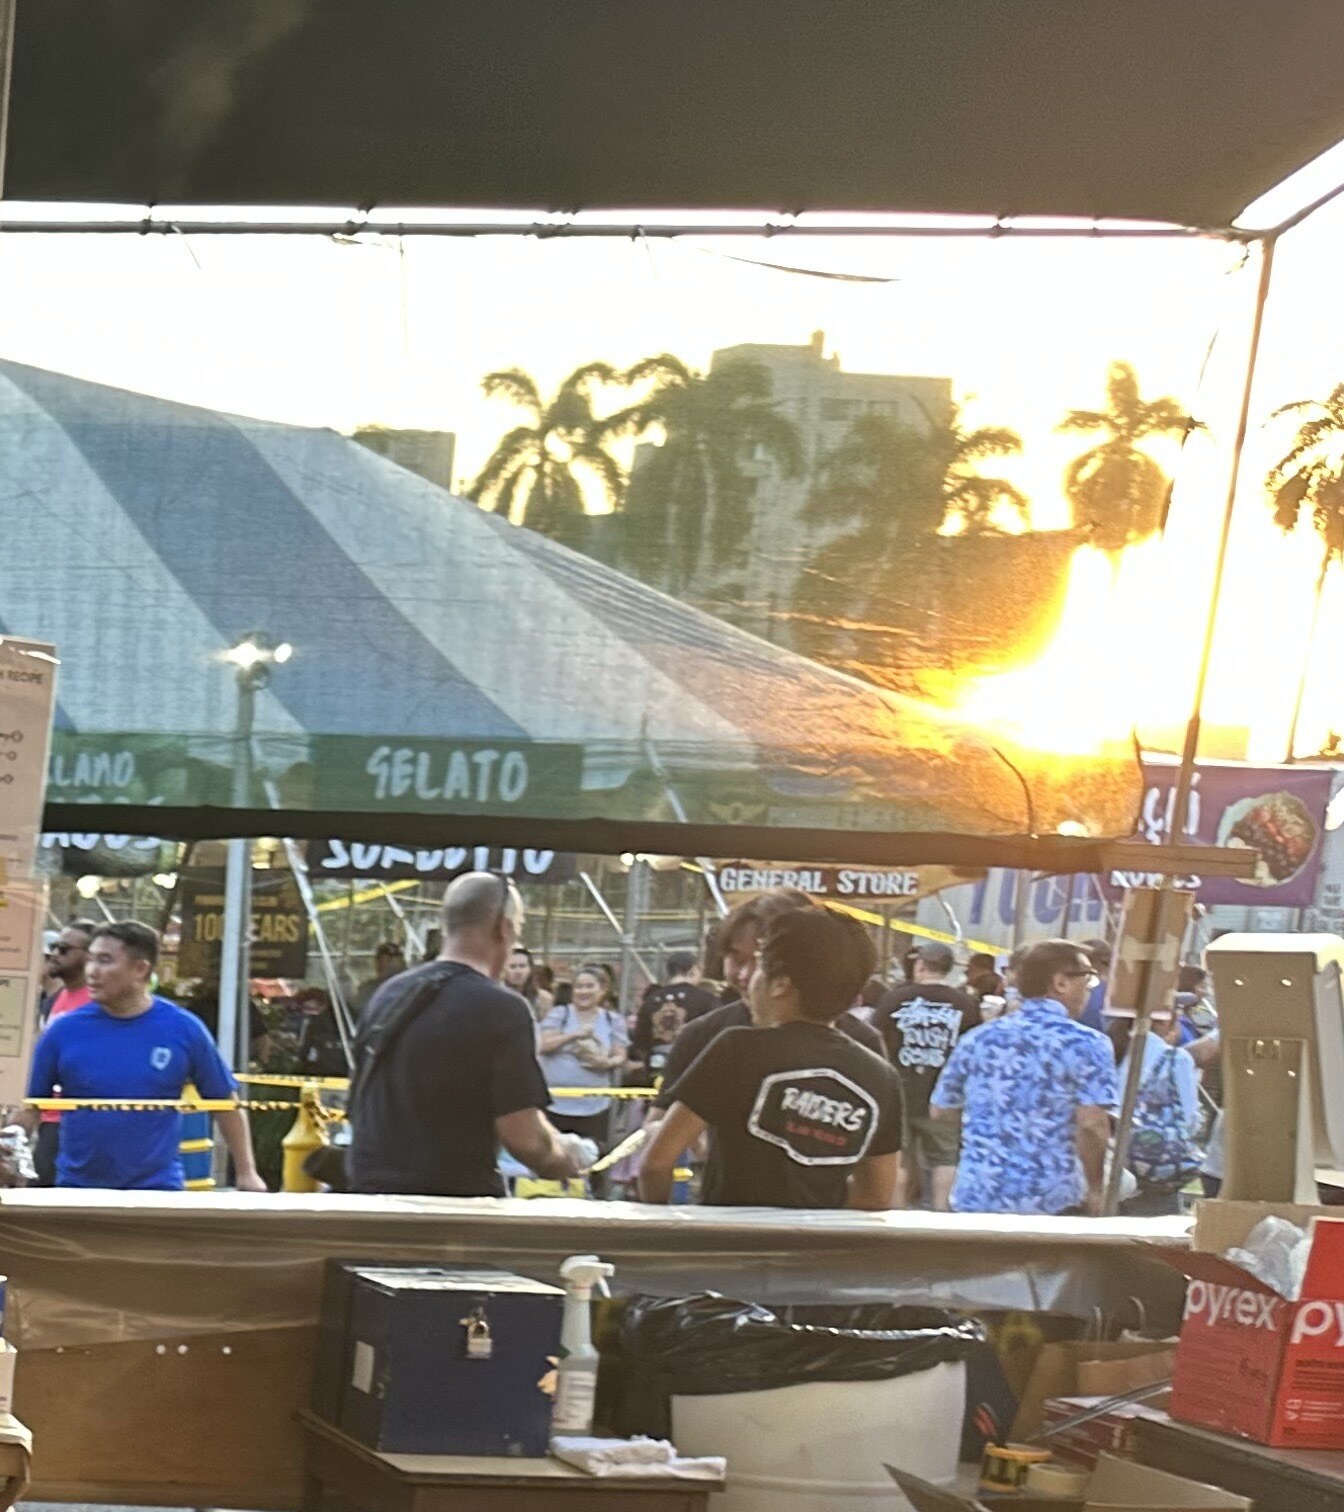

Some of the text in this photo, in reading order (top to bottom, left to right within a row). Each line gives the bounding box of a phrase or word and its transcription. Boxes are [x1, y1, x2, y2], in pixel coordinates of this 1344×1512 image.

[7, 670, 44, 685] RECIPE
[364, 745, 530, 803] GELATO
[719, 867, 919, 896] GENERAL STORE
[1182, 1279, 1278, 1332] pyrex
